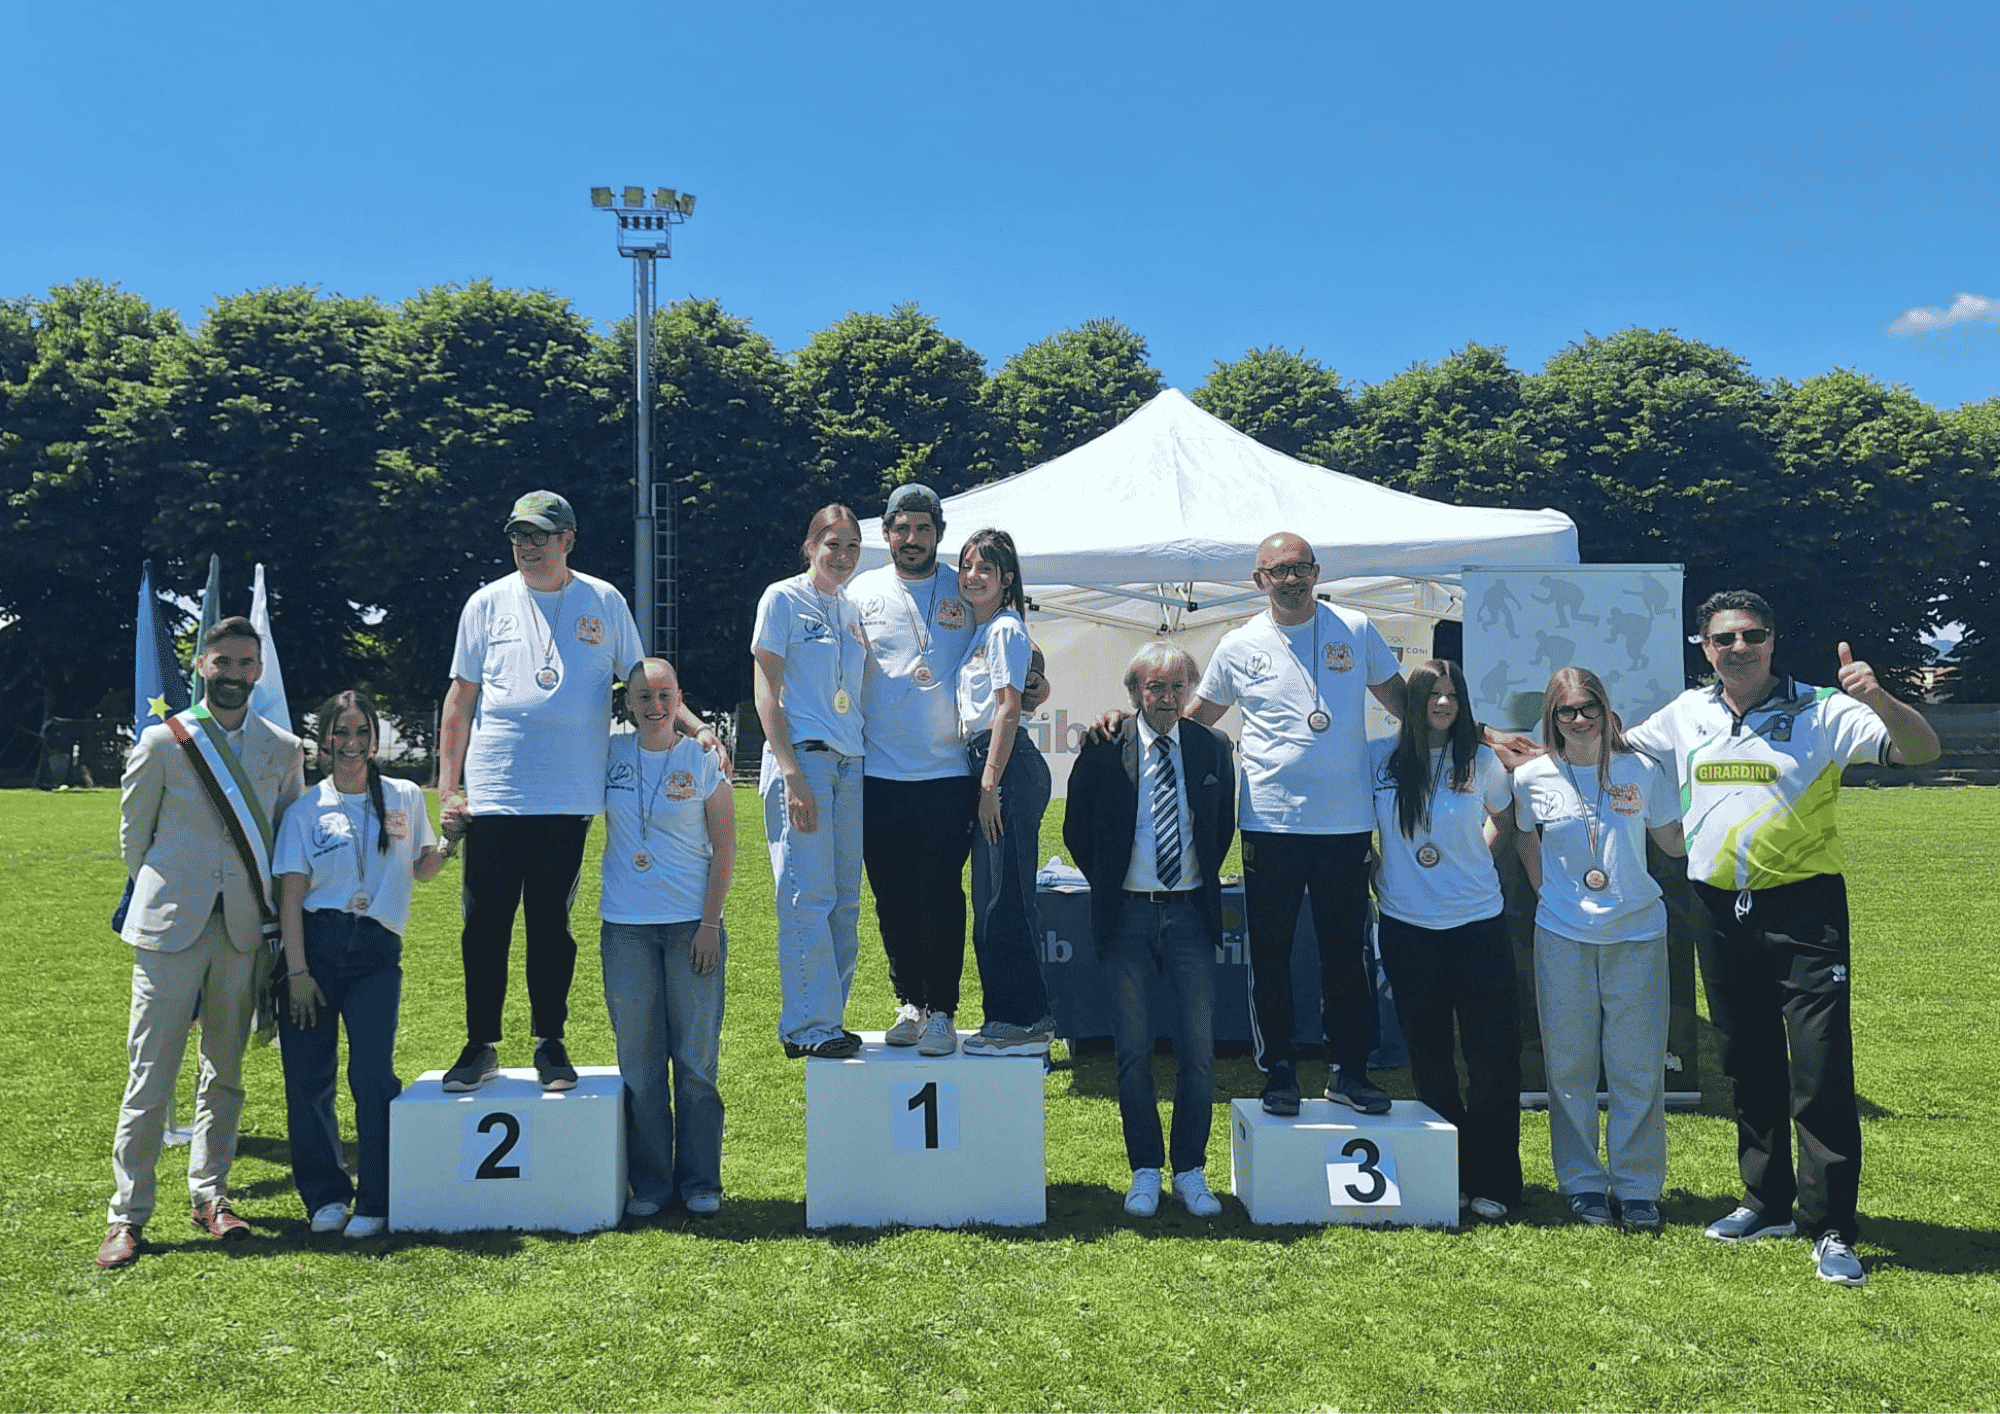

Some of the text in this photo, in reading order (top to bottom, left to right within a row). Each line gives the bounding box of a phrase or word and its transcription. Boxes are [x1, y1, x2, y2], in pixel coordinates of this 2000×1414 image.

[1406, 647, 1428, 655] CONI
[1700, 765, 1769, 779] GIRARDINI
[475, 1112, 520, 1179] 2
[908, 1082, 938, 1149] 1
[1341, 1138, 1387, 1203] 3
